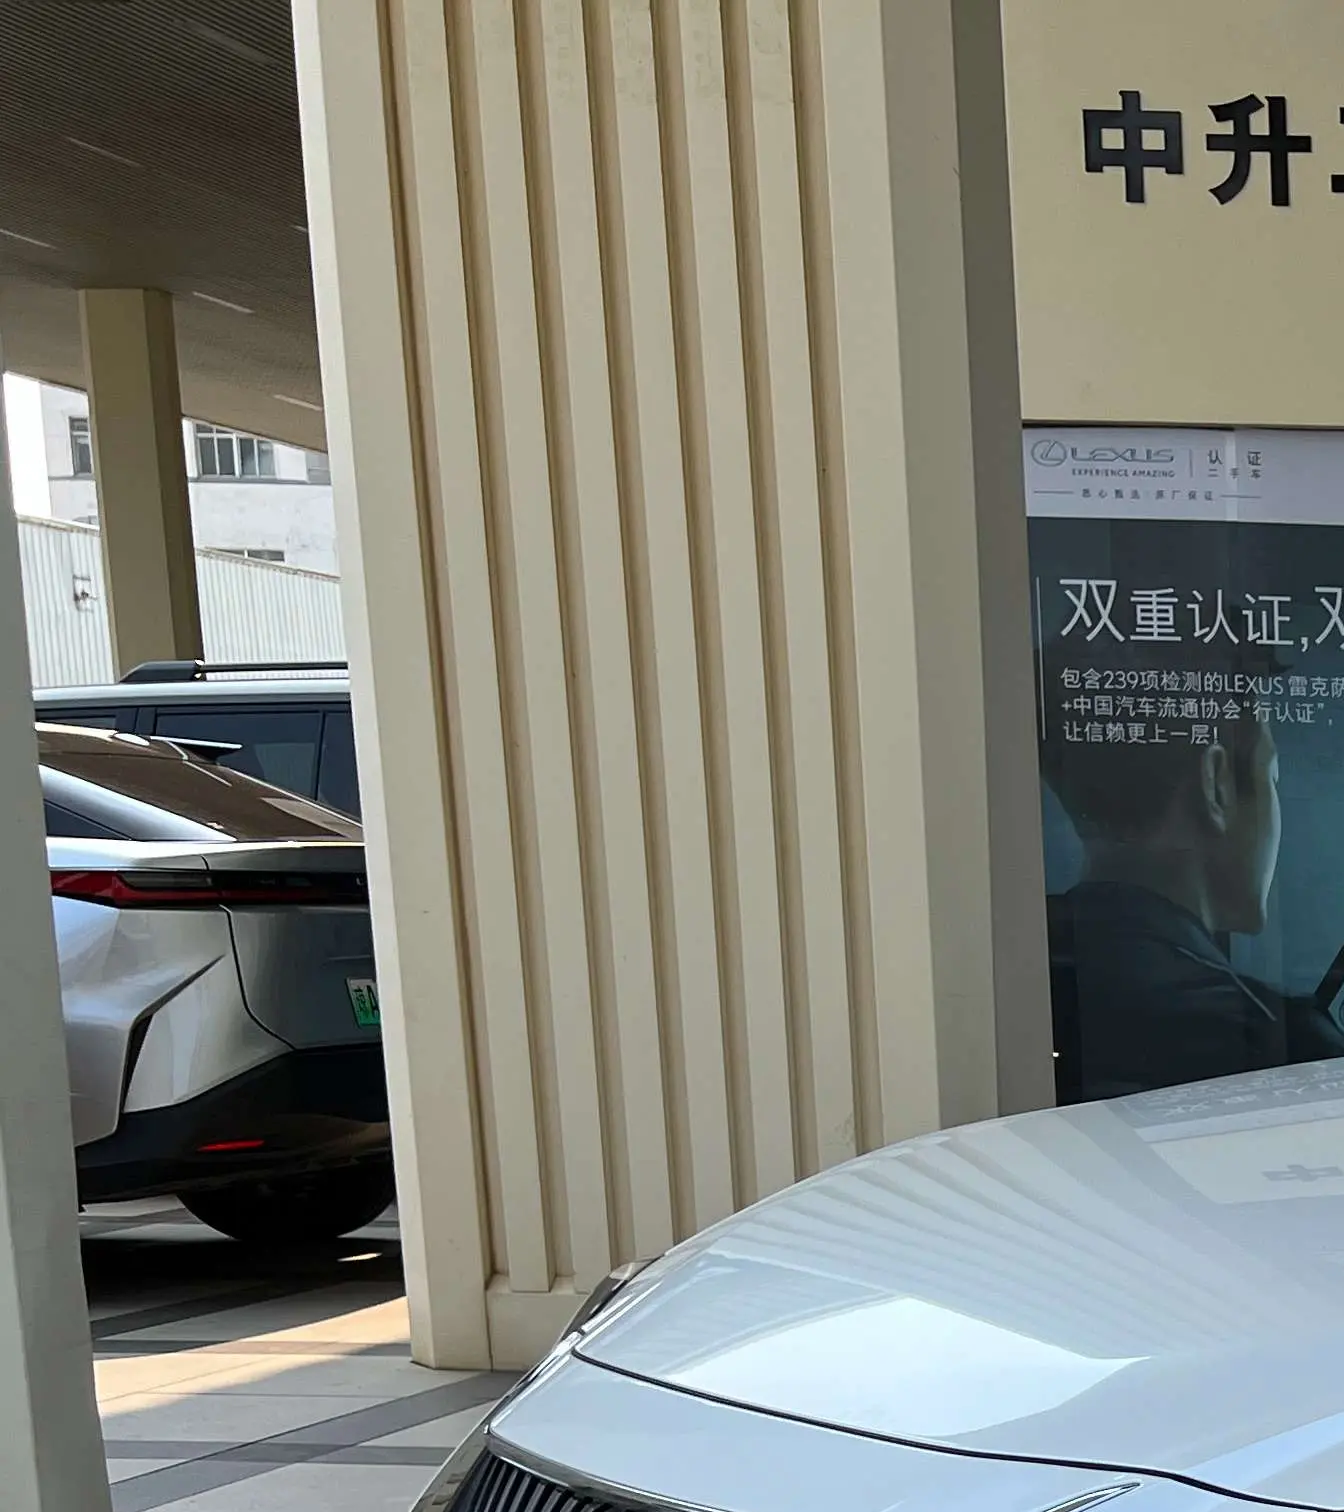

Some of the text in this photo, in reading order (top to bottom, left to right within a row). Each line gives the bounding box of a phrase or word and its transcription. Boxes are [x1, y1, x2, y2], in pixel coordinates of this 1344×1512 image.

[1070, 447, 1174, 463] LEXUS
[1208, 449, 1262, 466] 认证
[1072, 468, 1175, 478] EXPERIENCE AMAZING
[1208, 468, 1262, 480] 二手车
